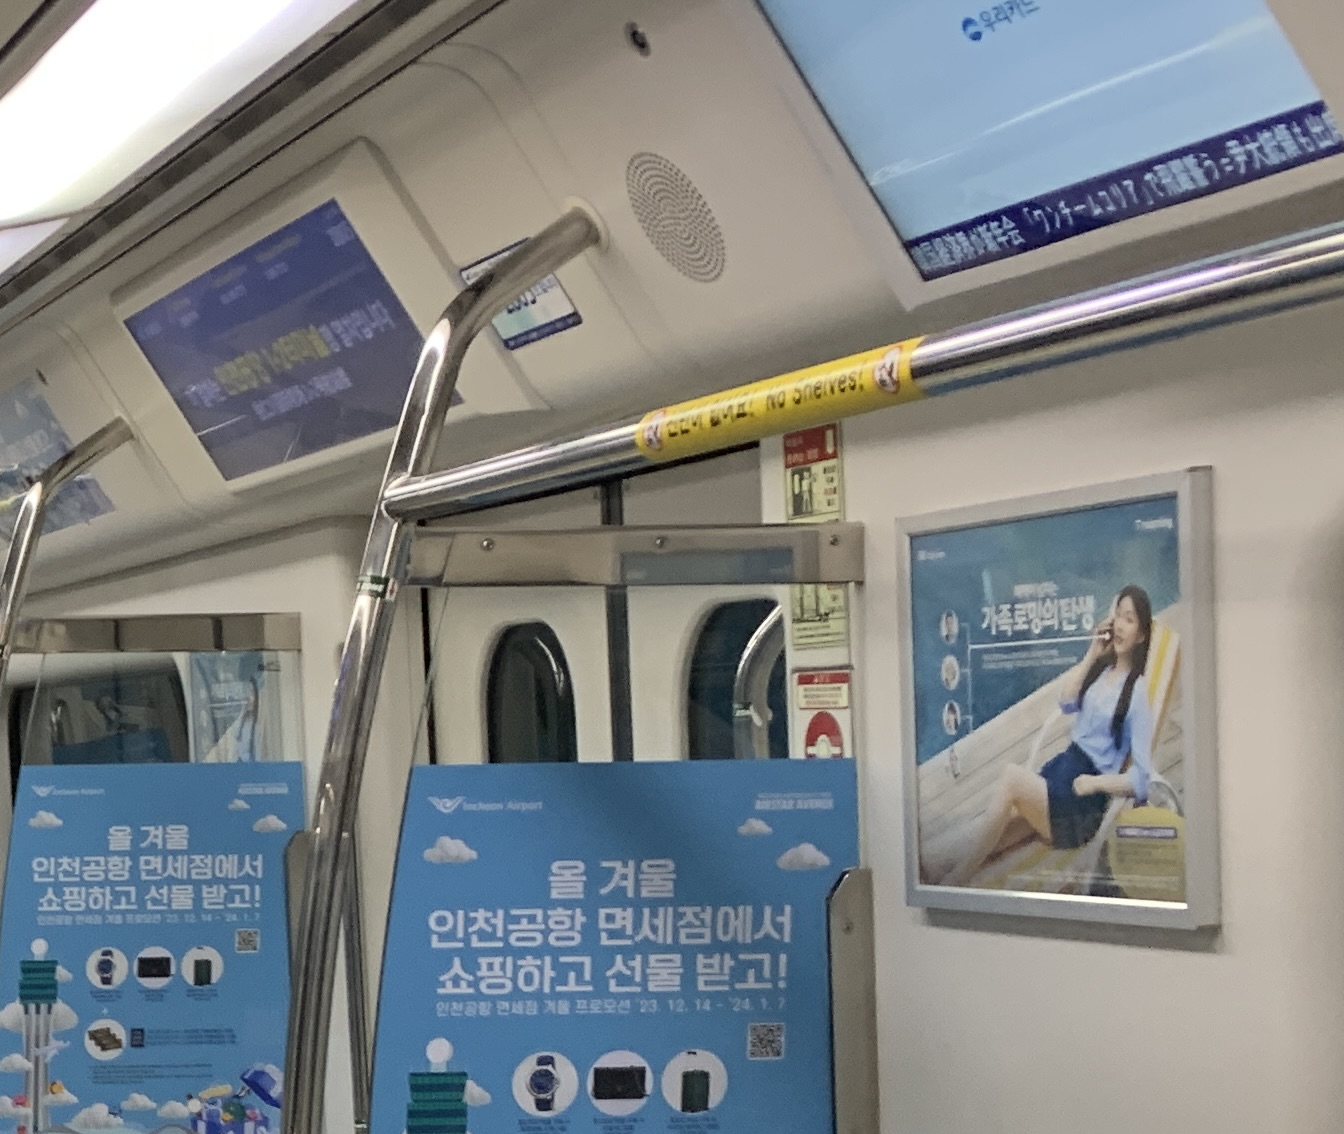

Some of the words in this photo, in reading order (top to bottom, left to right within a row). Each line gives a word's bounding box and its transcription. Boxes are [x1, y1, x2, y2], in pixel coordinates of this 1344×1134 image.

[32, 856, 132, 882] 인천공항
[139, 854, 263, 880] 면세점에서
[549, 859, 587, 899] 올
[599, 858, 677, 898] 겨울
[37, 886, 137, 912] 쇼핑하고
[144, 885, 194, 910] 선물
[202, 884, 260, 910] 받고!
[428, 908, 587, 948] 인천공항
[598, 905, 793, 945] 면세점에서
[436, 955, 593, 995] 쇼핑하고
[606, 954, 685, 993] 선물
[696, 952, 787, 991] 받고!
[436, 1001, 492, 1018] 인천공항
[497, 1001, 538, 1017] 면세점
[543, 1001, 570, 1016] 겨울
[576, 1000, 631, 1015] 프로모션
[696, 999, 711, 1014] 14
[778, 998, 786, 1013] 7
